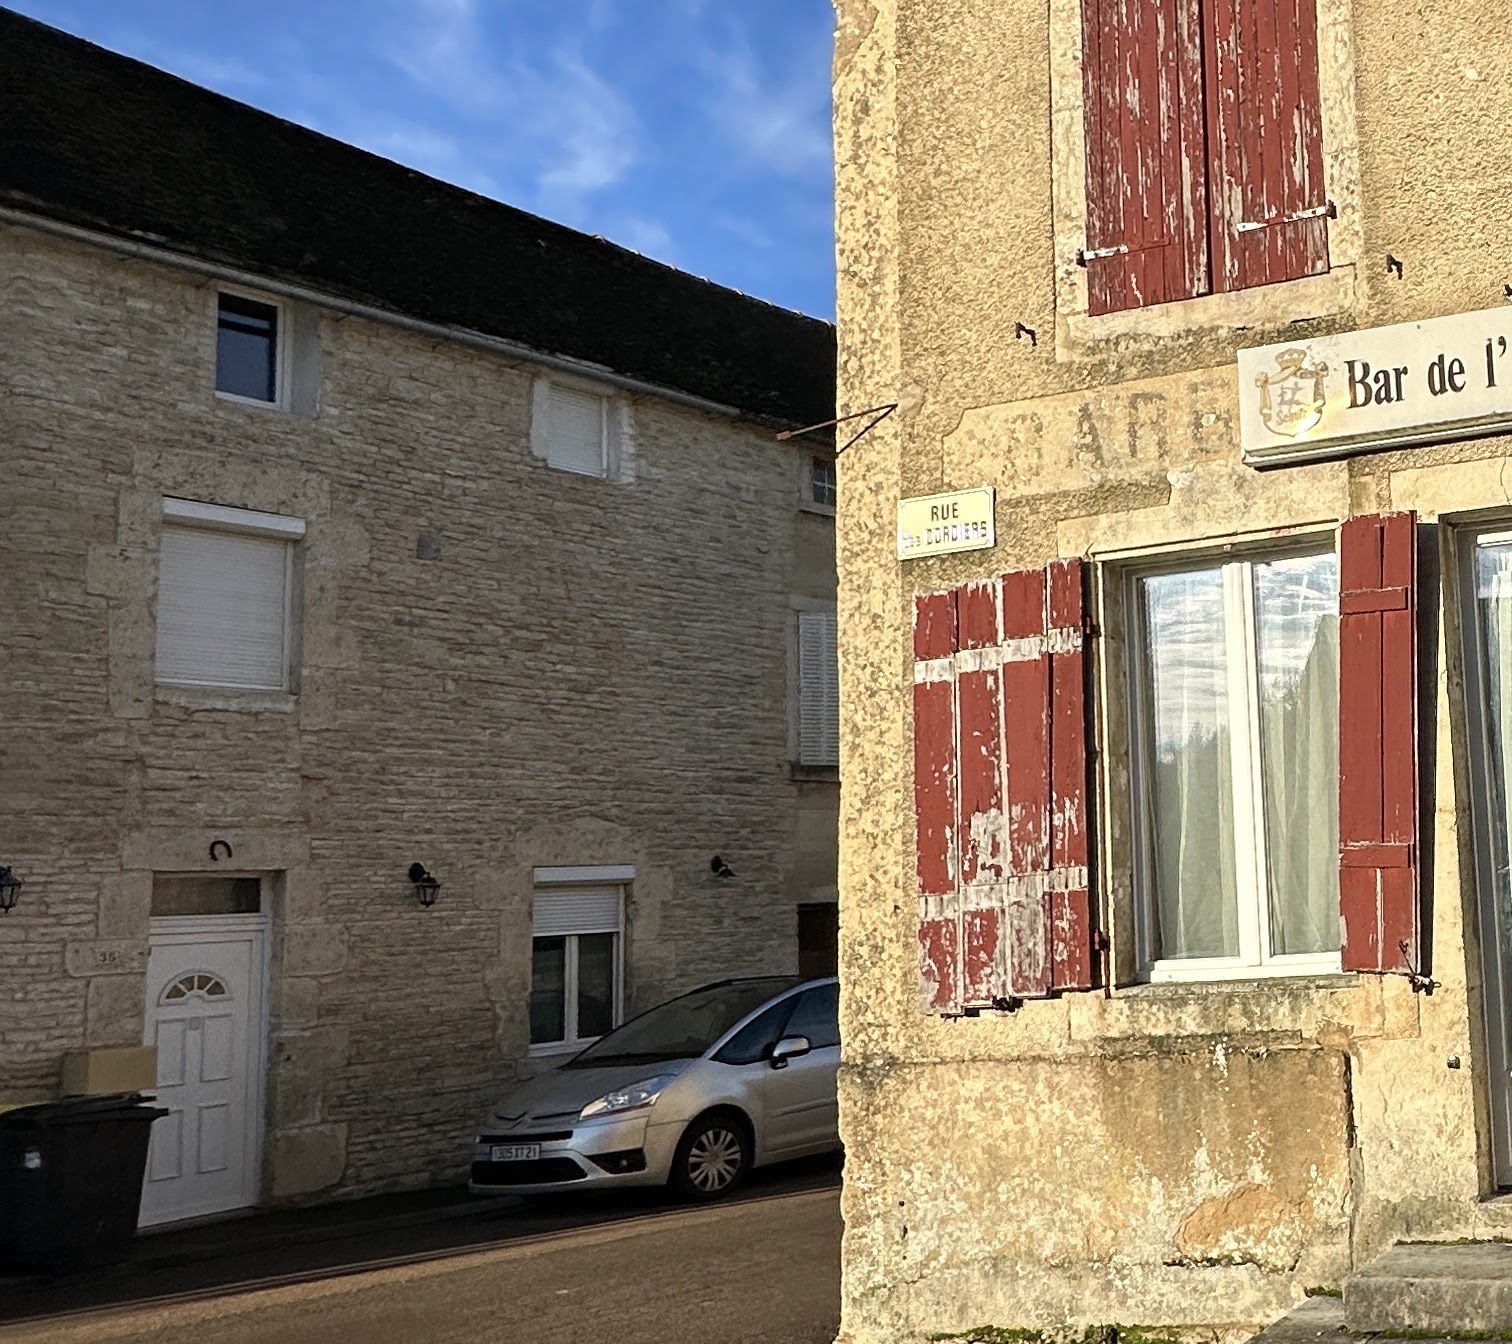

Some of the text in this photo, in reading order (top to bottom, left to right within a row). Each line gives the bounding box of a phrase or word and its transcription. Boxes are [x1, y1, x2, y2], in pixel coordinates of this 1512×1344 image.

[1343, 358, 1409, 410] Bar
[1427, 353, 1467, 397] de
[931, 502, 959, 522] RUE
